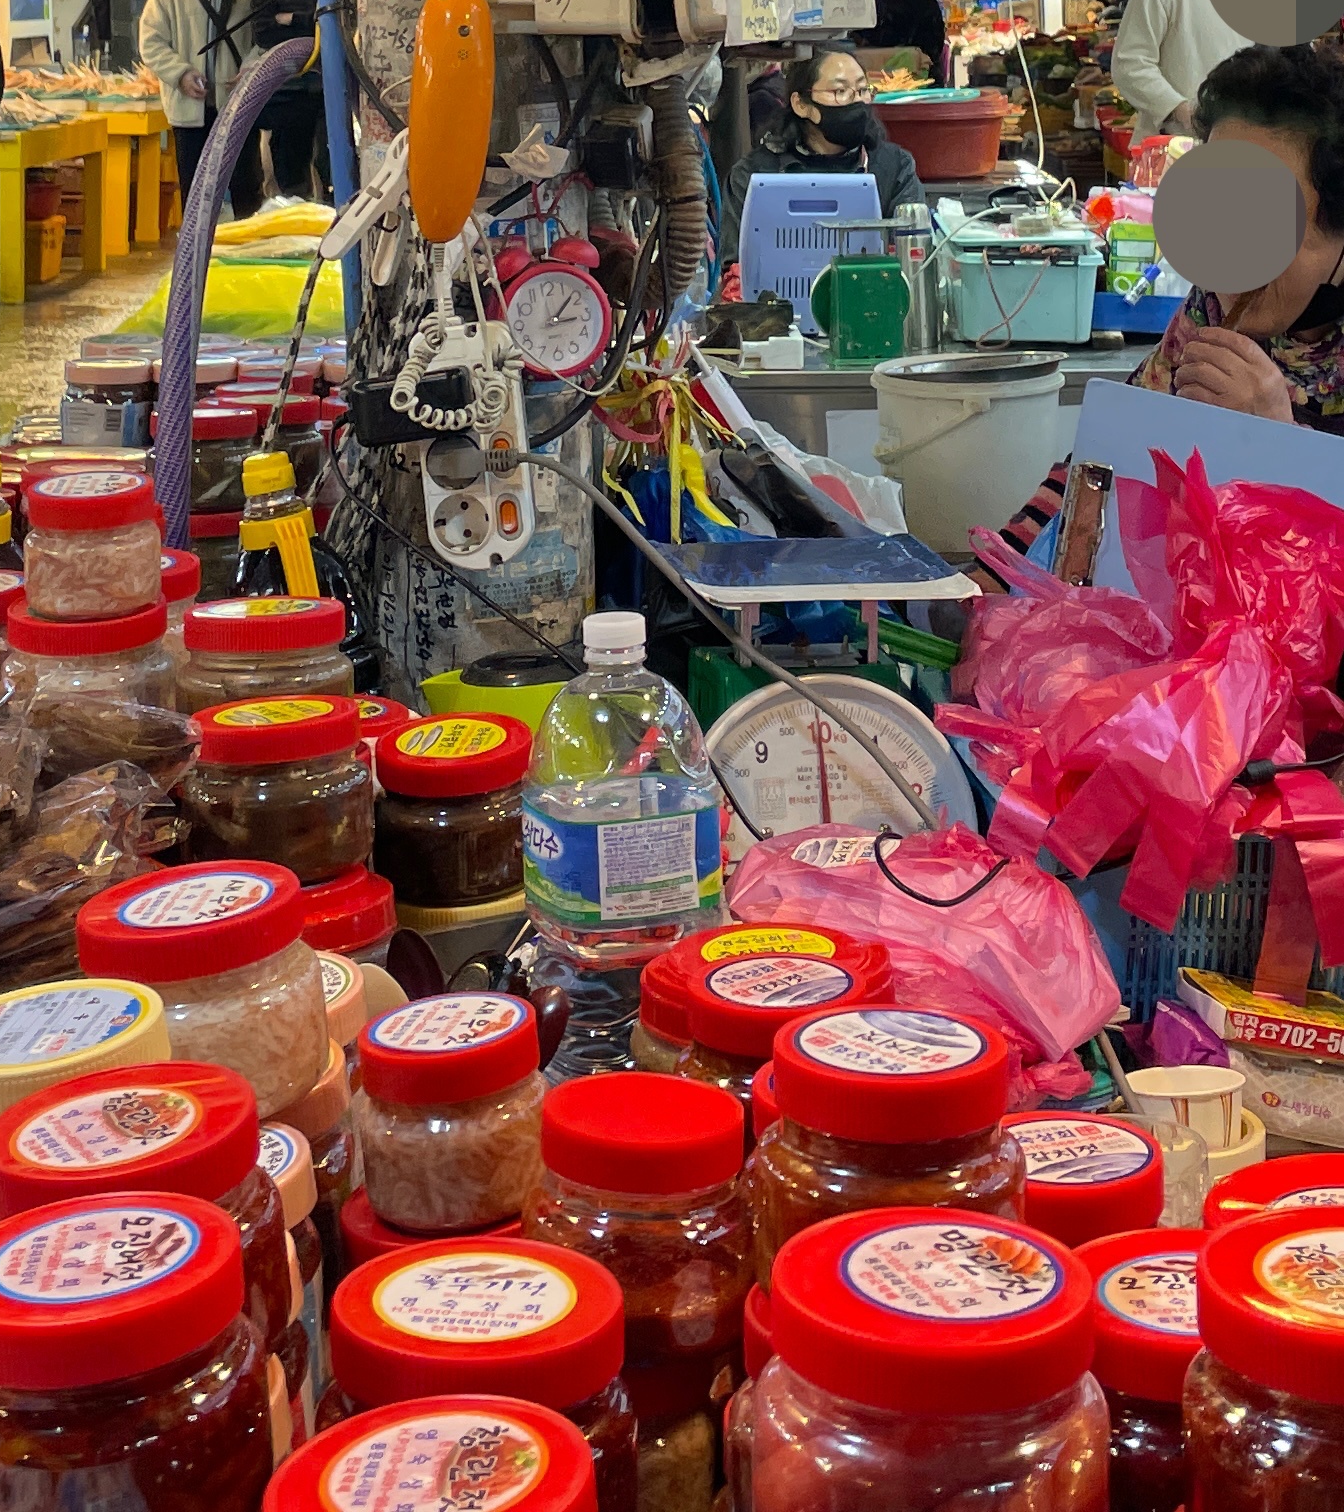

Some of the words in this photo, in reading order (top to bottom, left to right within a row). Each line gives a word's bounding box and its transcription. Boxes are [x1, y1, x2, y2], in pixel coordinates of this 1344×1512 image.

[541, 280, 555, 296] 12
[560, 280, 565, 293] 1
[528, 289, 536, 303] 11
[572, 291, 582, 305] 2
[517, 303, 533, 317] 10
[580, 308, 591, 322] 3
[515, 320, 525, 332] 9
[579, 324, 589, 338] 4
[522, 334, 533, 349] 8
[569, 340, 579, 354] 5
[537, 345, 546, 359] 7
[553, 347, 563, 361] 6
[779, 727, 795, 736] 500
[807, 721, 832, 744] 10
[833, 733, 848, 744] kg
[755, 741, 768, 764] 9
[734, 767, 750, 778] 500
[193, 878, 245, 922] 새우젓
[442, 999, 499, 1048] 새우젓
[1233, 1014, 1259, 1029] 감자
[101, 1215, 158, 1289] 오징어젓
[936, 1227, 1041, 1302] 명란젓
[1117, 1271, 1198, 1292] 오징
